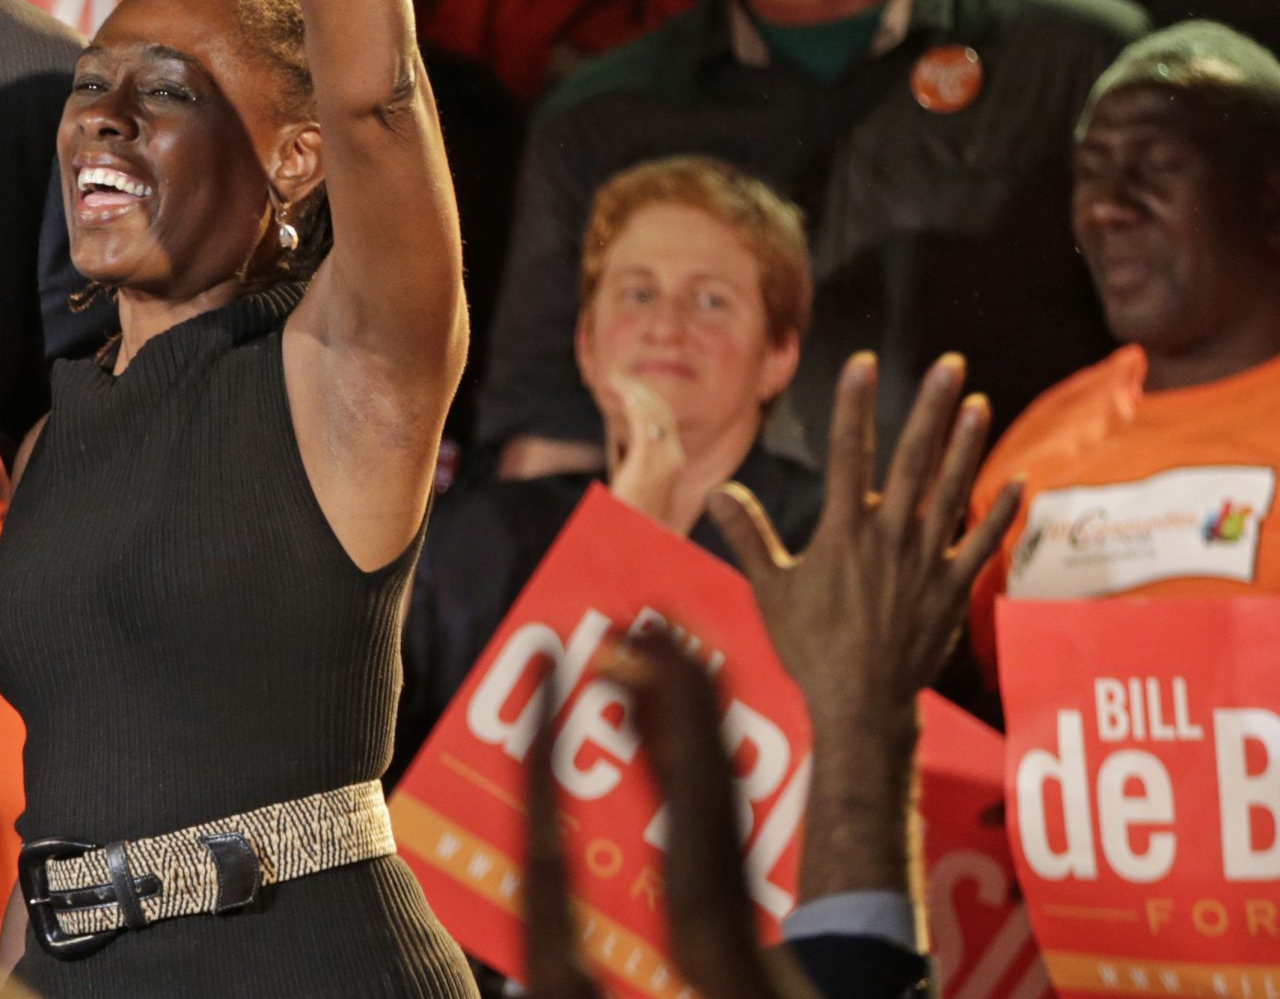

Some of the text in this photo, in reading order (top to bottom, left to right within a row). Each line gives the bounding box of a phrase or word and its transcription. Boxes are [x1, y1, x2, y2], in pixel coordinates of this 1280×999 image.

[1093, 675, 1204, 742] BILL
[1016, 707, 1177, 884] de
[1144, 897, 1280, 939] FOR
